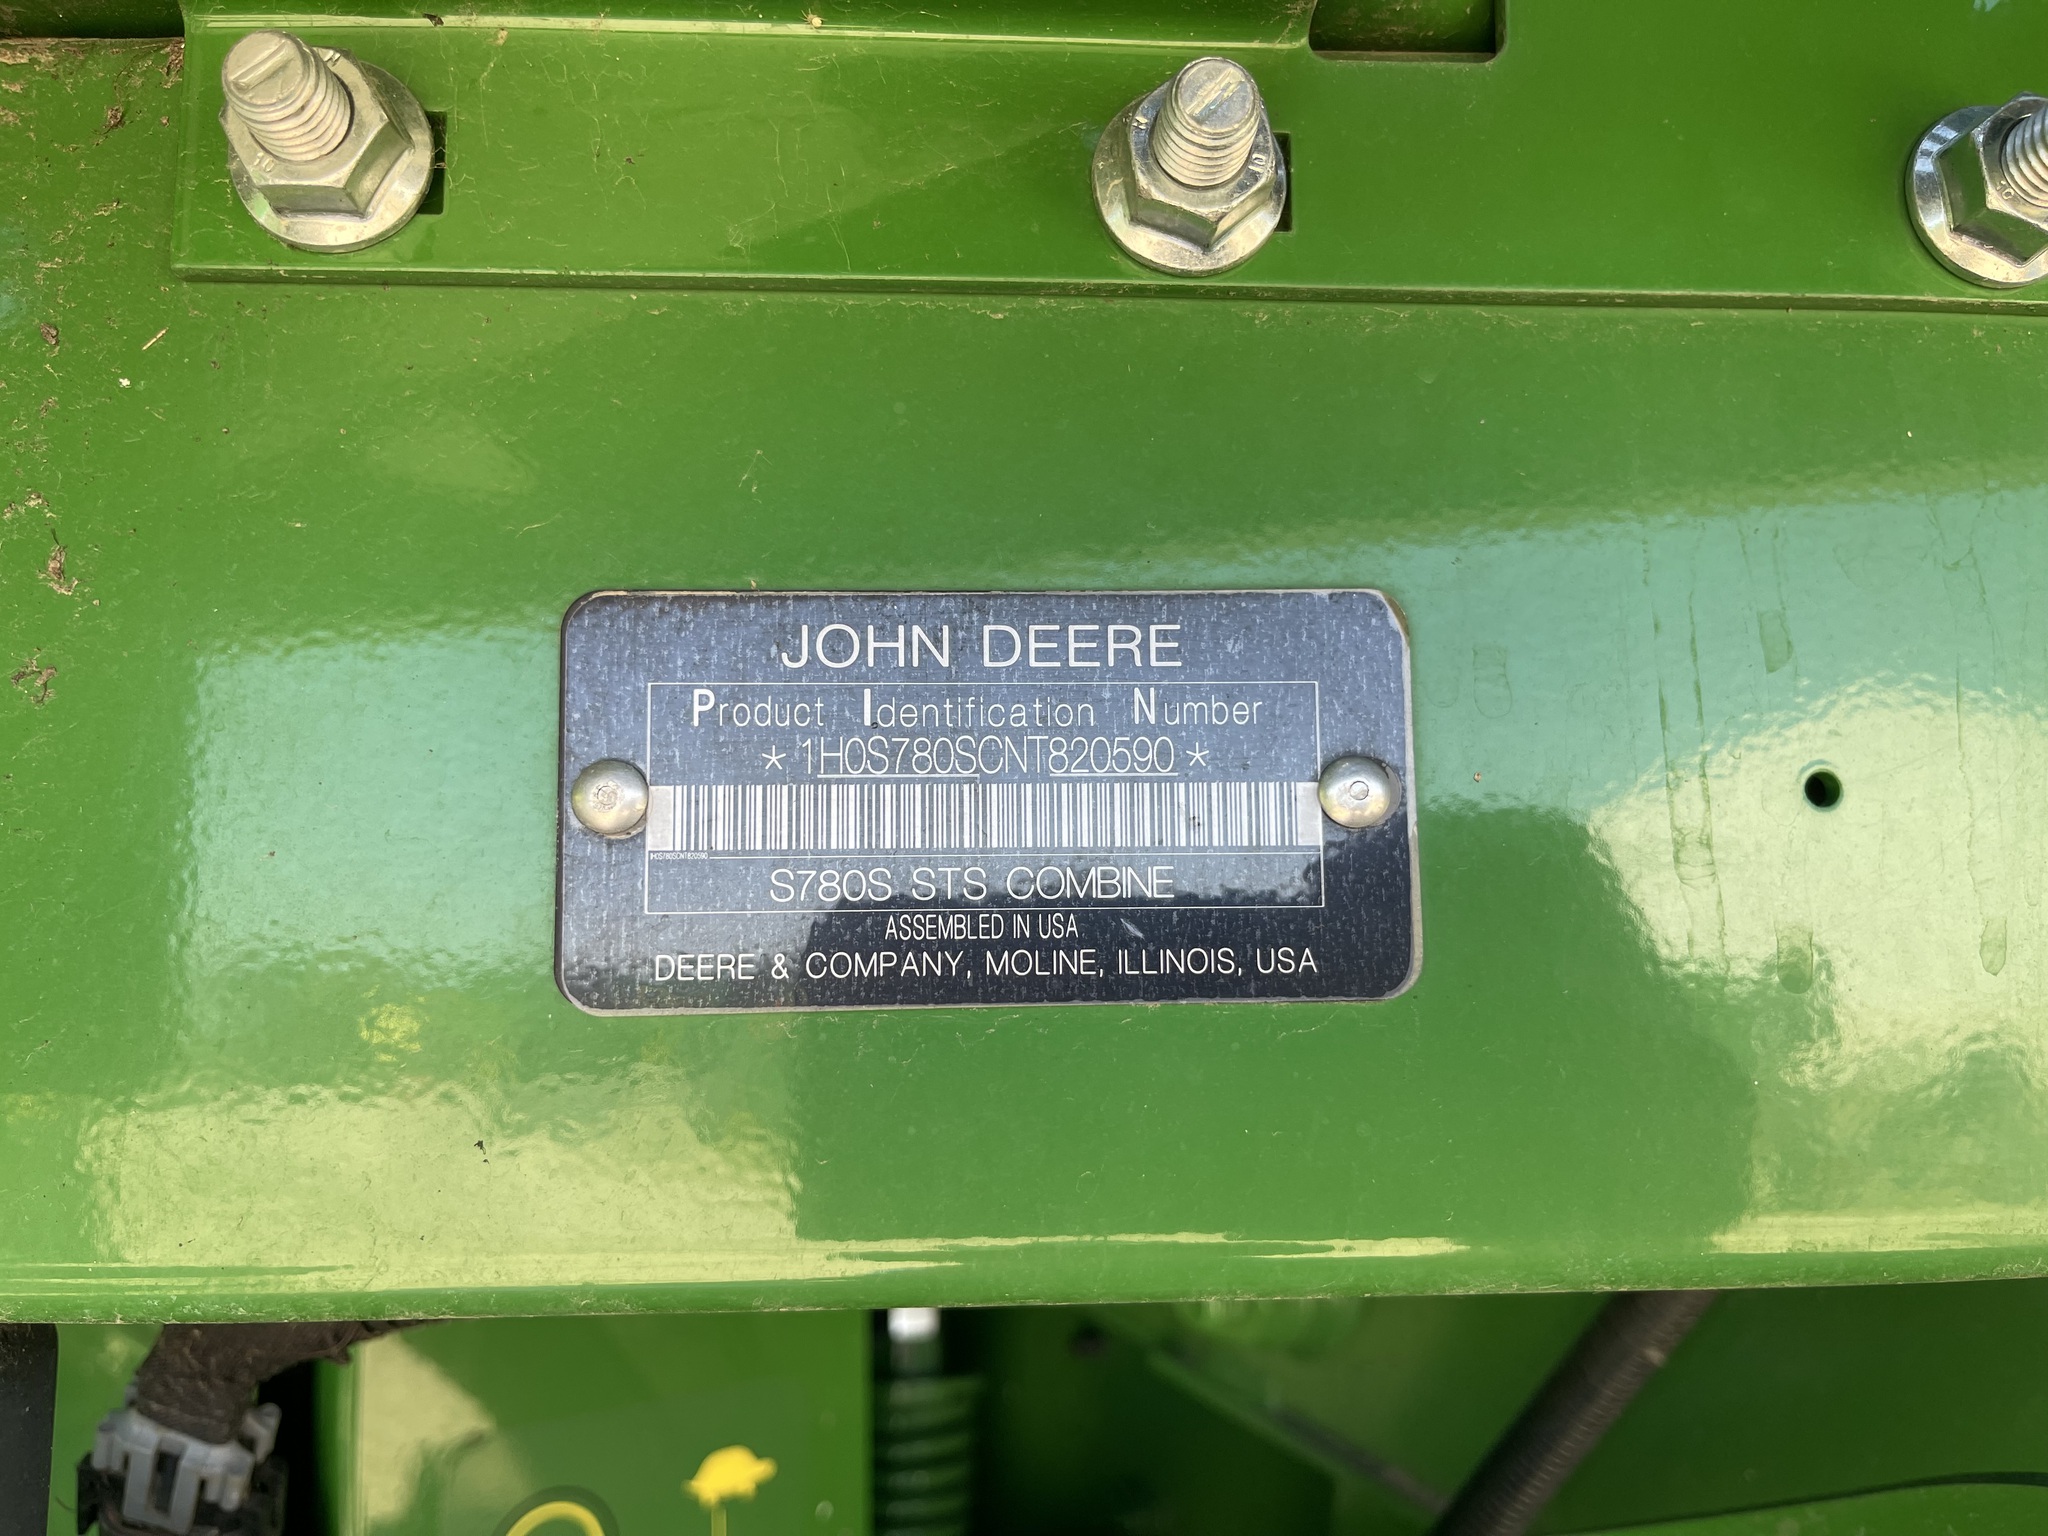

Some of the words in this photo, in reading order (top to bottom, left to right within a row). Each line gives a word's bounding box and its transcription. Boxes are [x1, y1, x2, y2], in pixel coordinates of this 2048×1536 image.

[781, 624, 951, 668] JOHN
[982, 624, 1182, 668] DEERE
[692, 688, 825, 728] Product
[862, 687, 1095, 728] Identification
[1133, 686, 1263, 726] Number
[769, 867, 893, 902] S780S
[911, 866, 987, 901] STS
[1006, 865, 1175, 899] COMBINE
[884, 914, 1004, 941] ASSEMBLED
[1013, 914, 1031, 939] IN
[1037, 913, 1079, 939] USA
[654, 953, 756, 982] DEERE
[771, 953, 790, 980] &
[805, 950, 973, 980] COMPANY,
[986, 948, 1104, 978] MOLINE,
[1118, 947, 1243, 976] ILLINOIS,
[1256, 946, 1318, 974] USA
